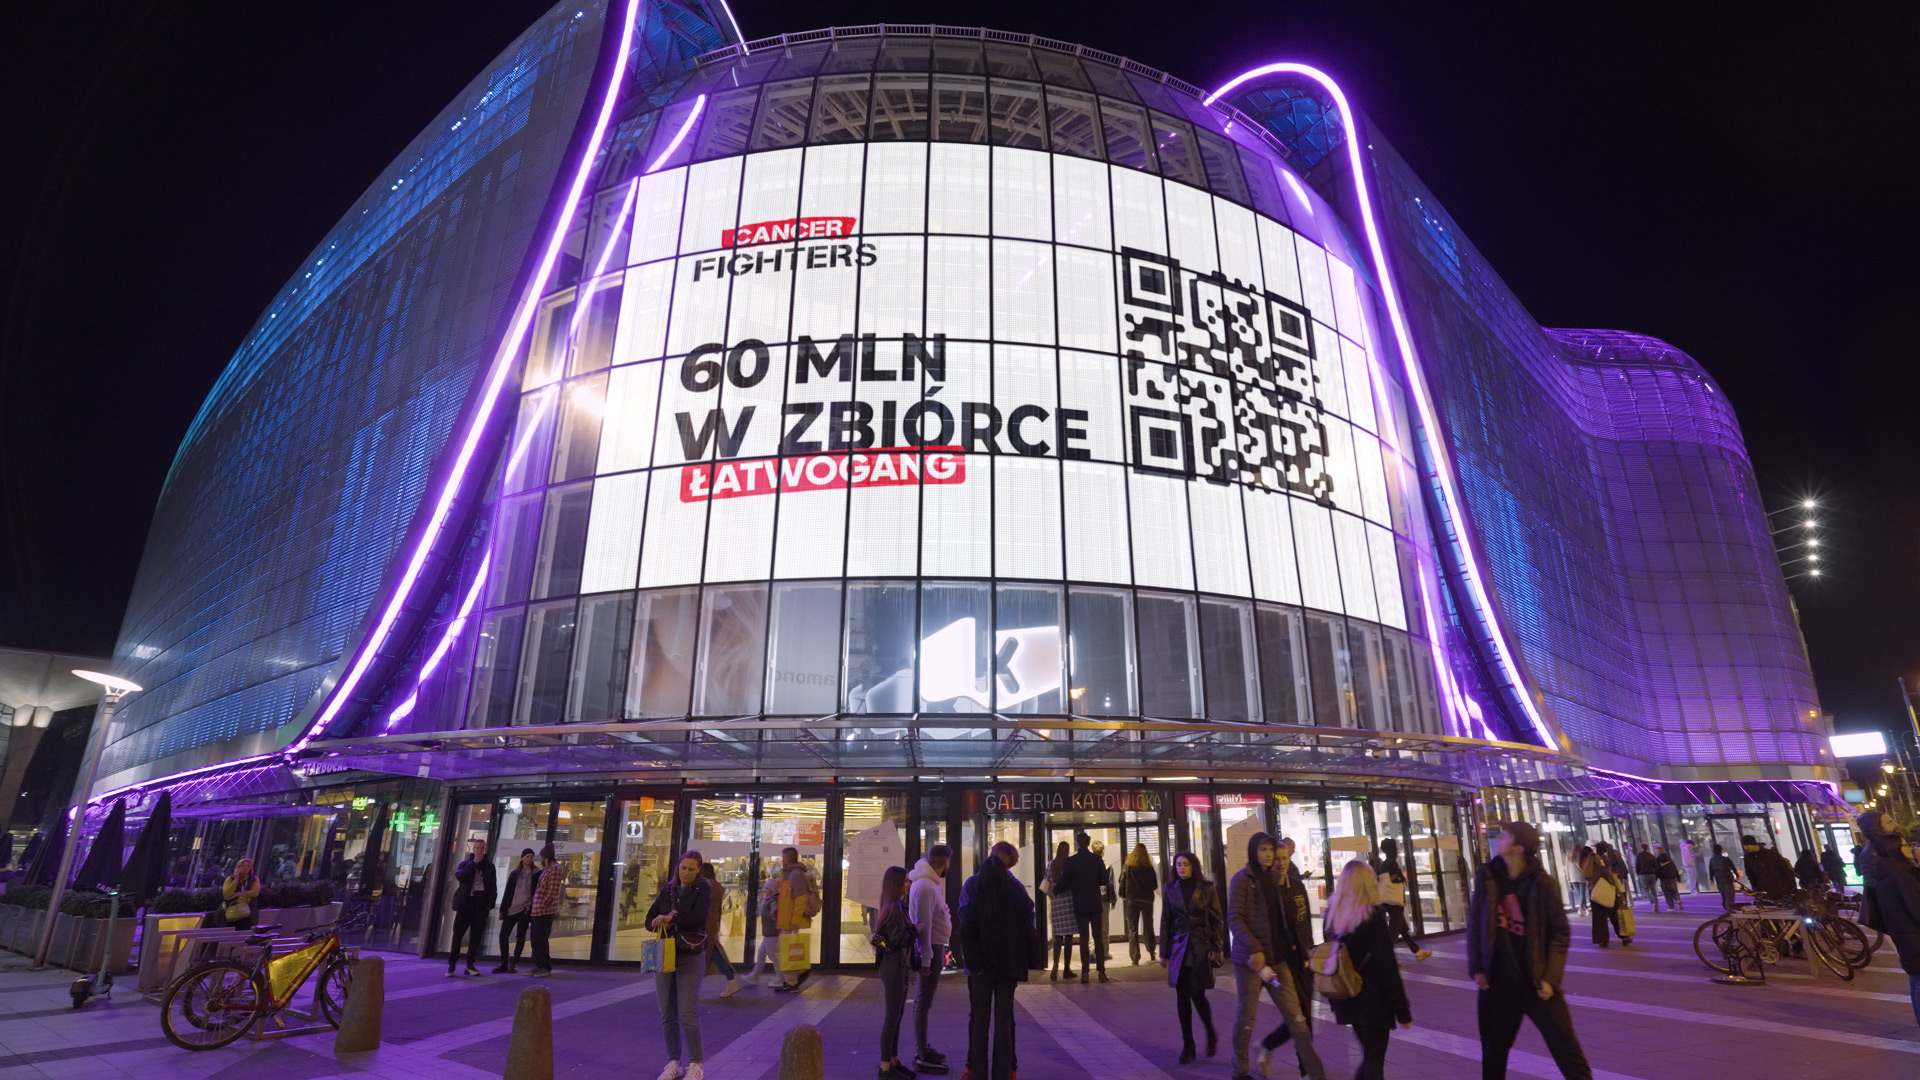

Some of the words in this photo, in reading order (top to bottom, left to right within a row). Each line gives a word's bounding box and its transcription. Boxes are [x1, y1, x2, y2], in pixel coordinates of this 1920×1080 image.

[732, 219, 844, 246] CANCER
[693, 243, 878, 283] FIGHTERS
[679, 338, 771, 393] 60
[795, 332, 947, 385] MLN
[674, 405, 757, 461] W
[777, 386, 1092, 461] ZBIÓRCE
[688, 451, 958, 497] ŁATWOGANG
[985, 792, 1064, 811] GALERIA
[1071, 792, 1163, 811] KATOWICKA
